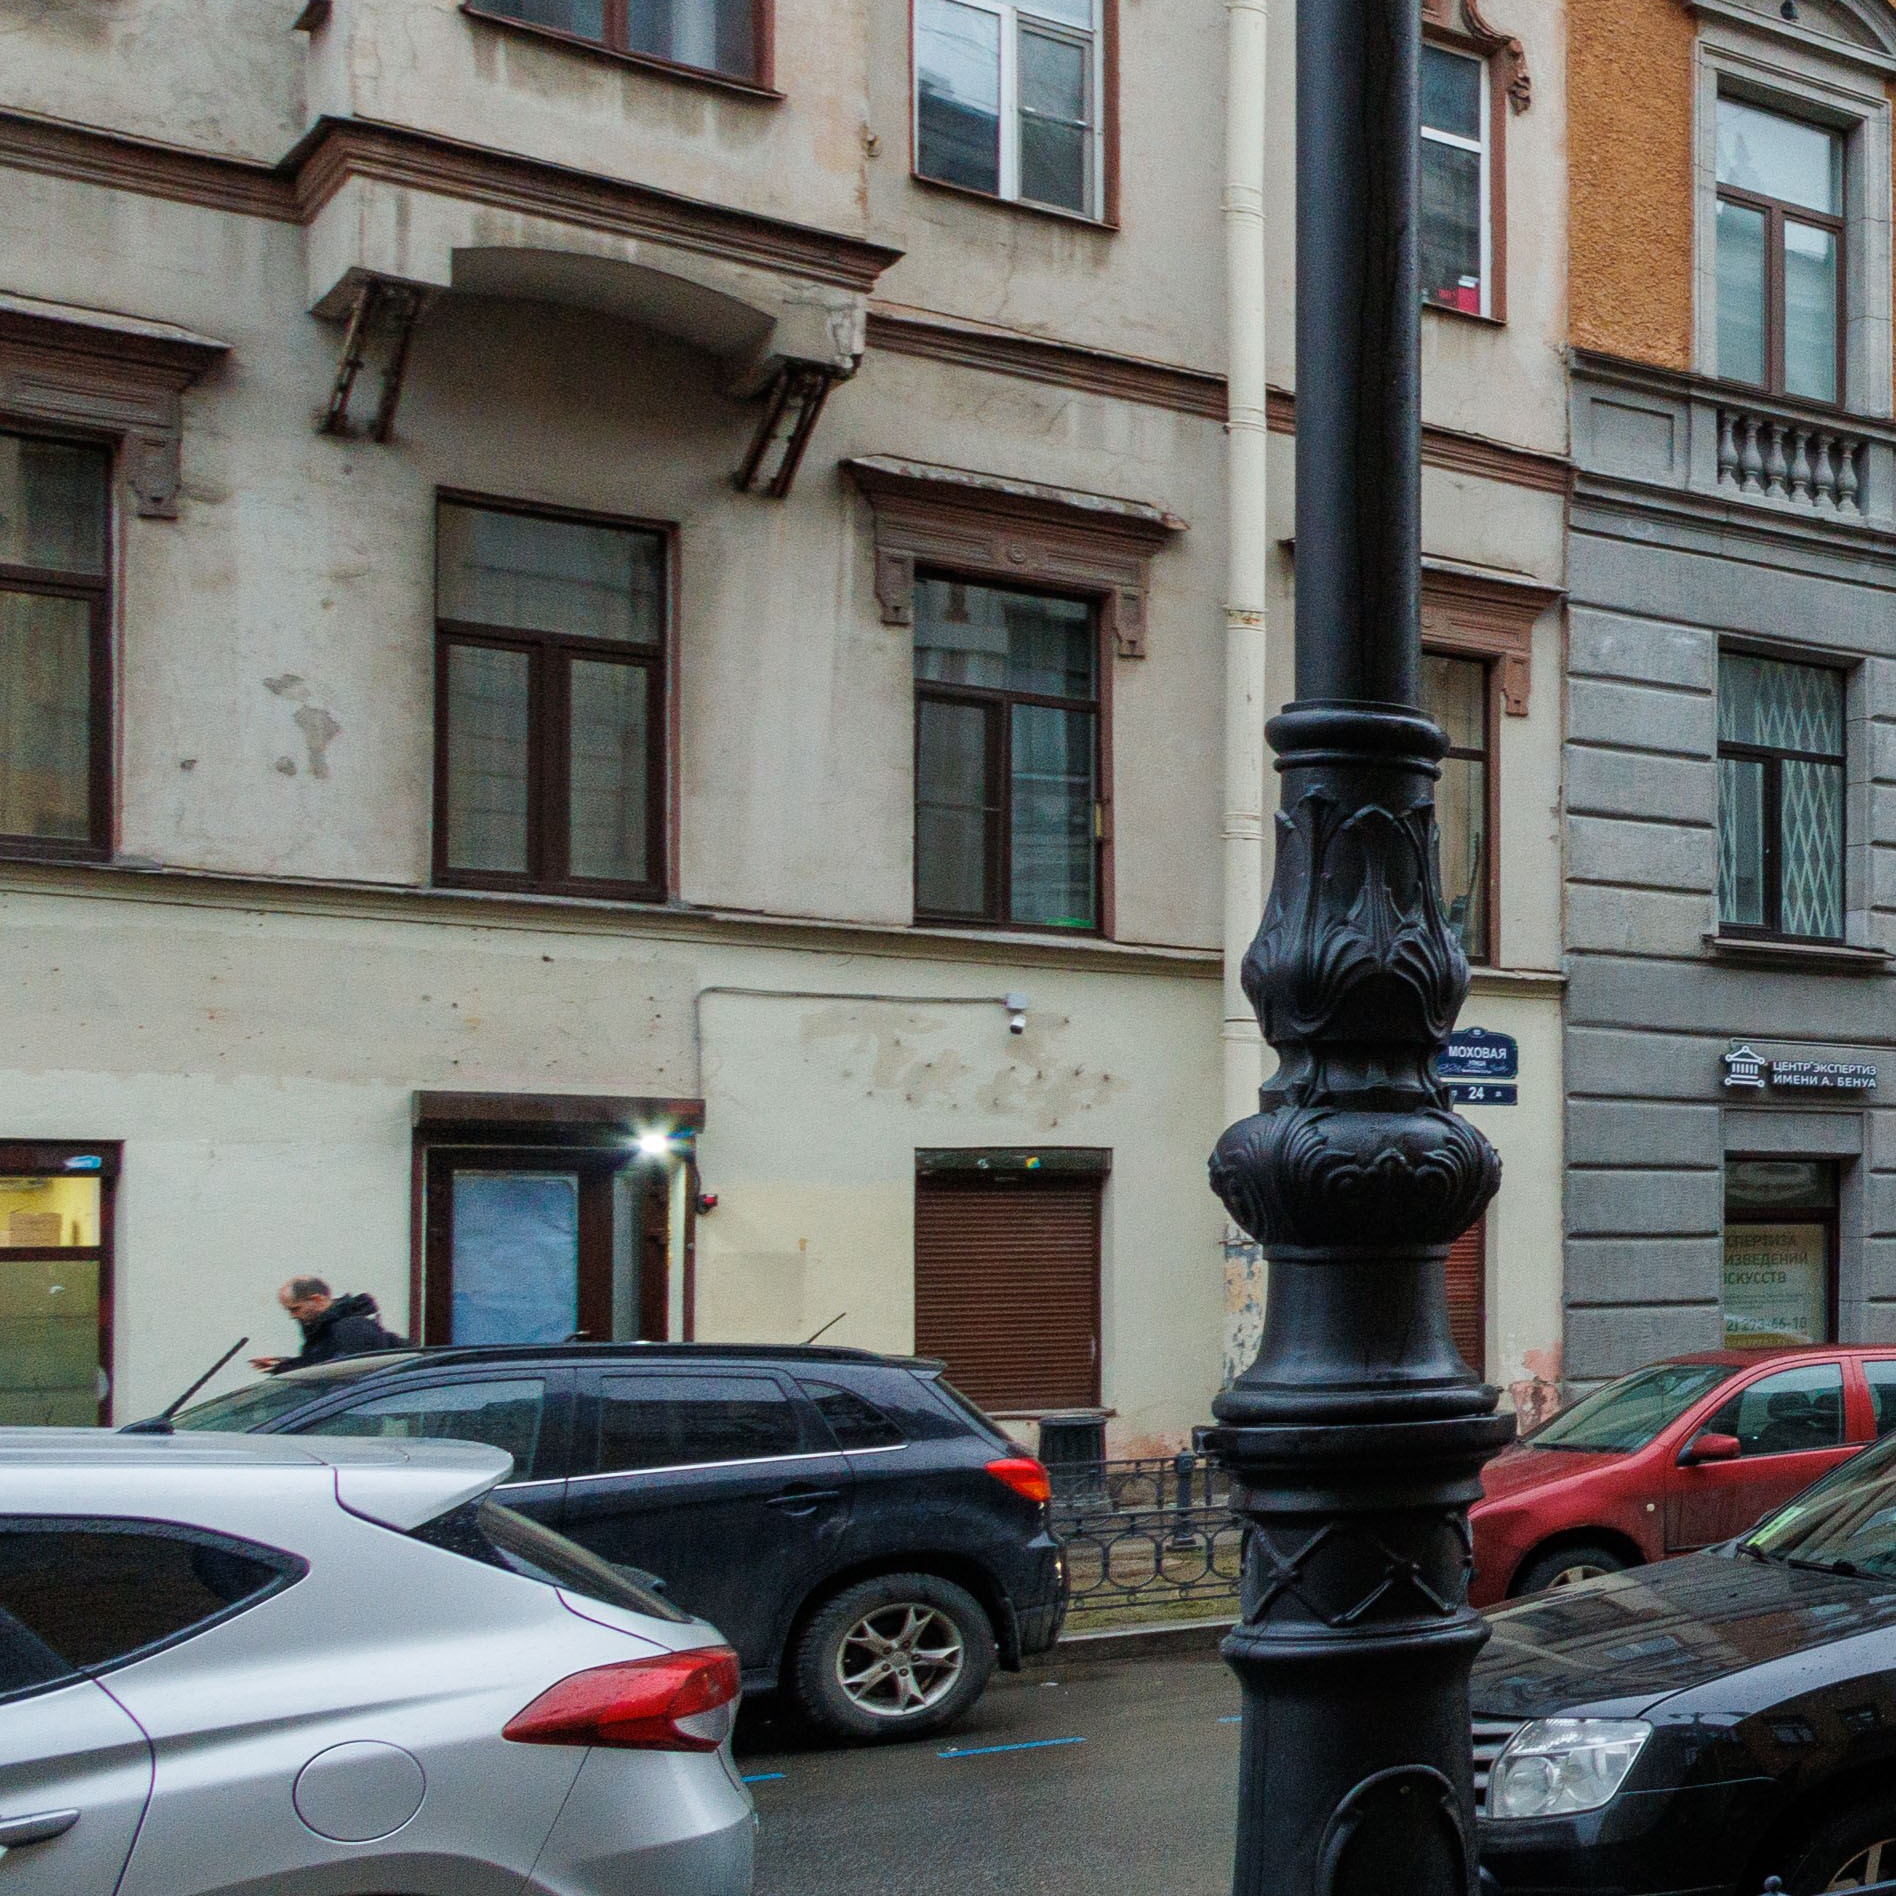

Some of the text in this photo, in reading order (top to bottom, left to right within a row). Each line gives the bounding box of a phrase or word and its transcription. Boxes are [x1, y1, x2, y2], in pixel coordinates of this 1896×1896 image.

[1448, 1045, 1507, 1059] МОХОВАЯ
[1772, 1061, 1877, 1075] ЦЕНТР ЭКСПЕРТИЗ
[1773, 1076, 1877, 1088] ИМЕНИ А. БЕНУА
[1468, 1086, 1485, 1100] 24
